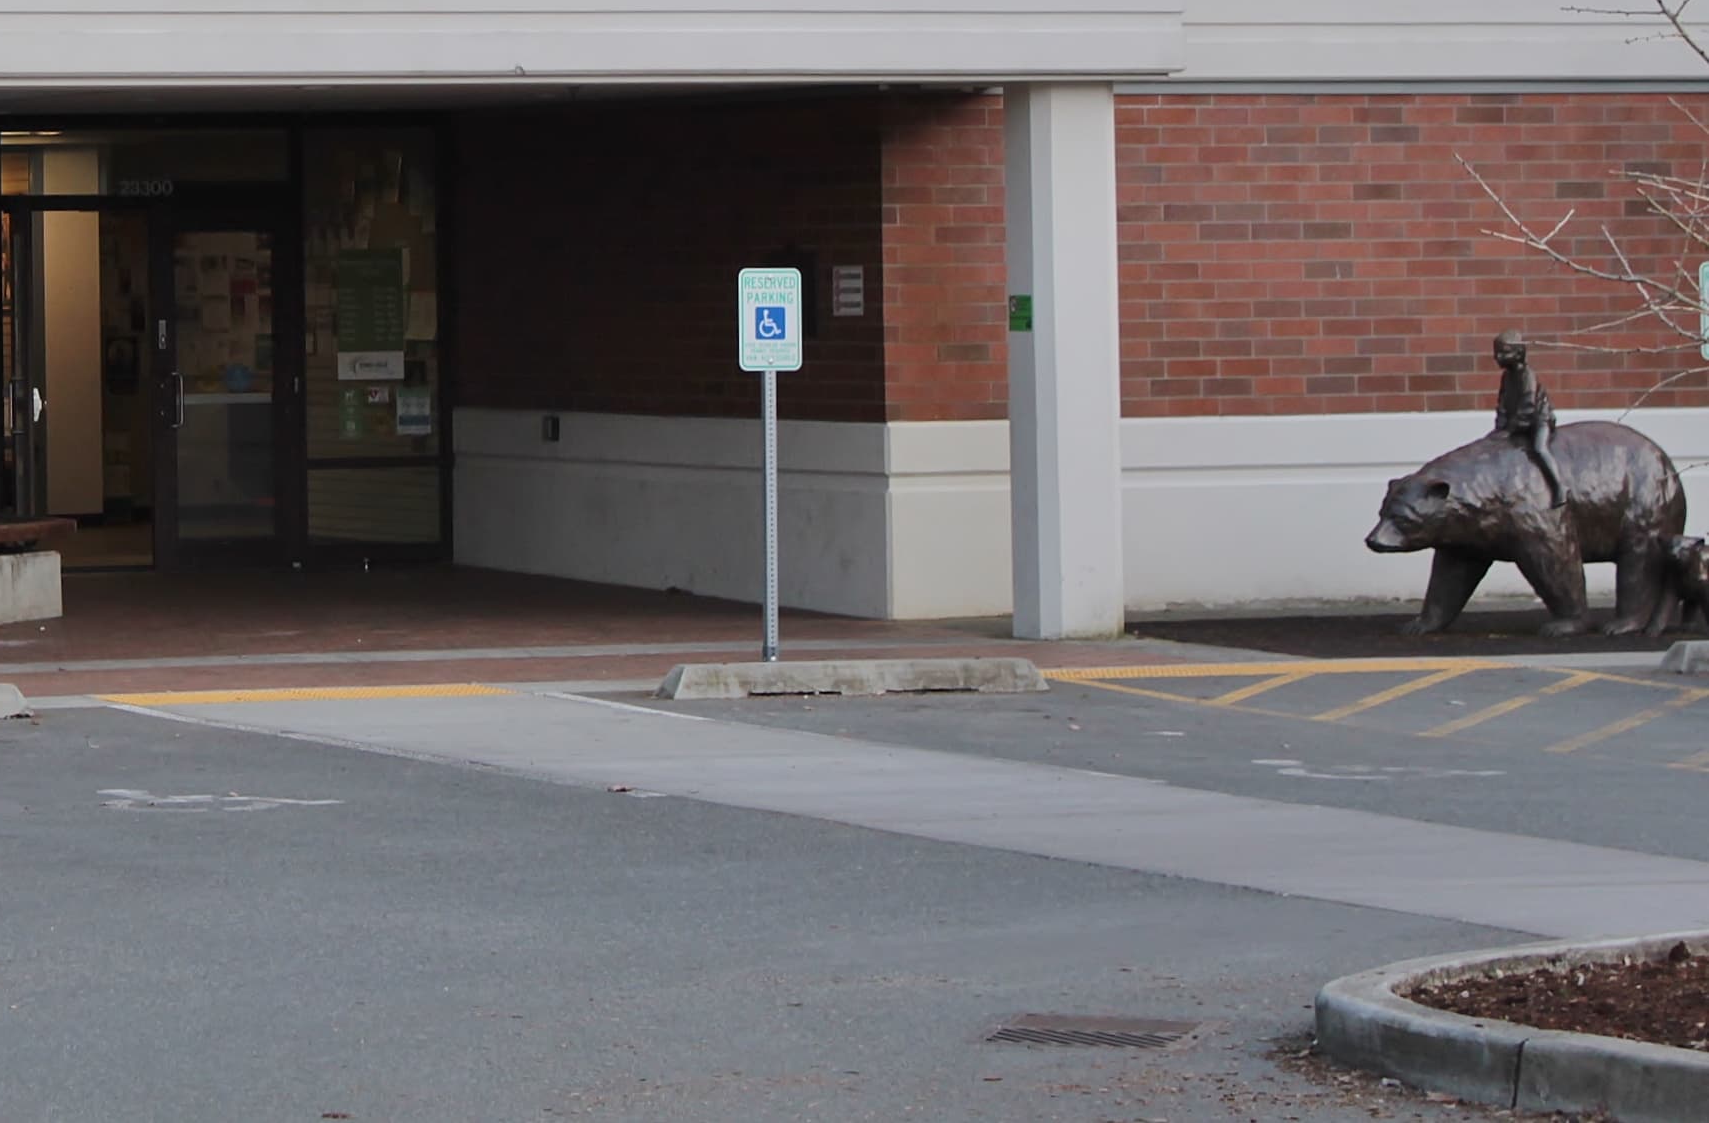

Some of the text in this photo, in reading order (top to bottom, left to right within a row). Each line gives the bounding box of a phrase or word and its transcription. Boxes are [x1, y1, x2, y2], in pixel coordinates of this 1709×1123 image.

[119, 180, 173, 196] 23300
[744, 276, 796, 289] RESERVED
[746, 292, 794, 305] PARKING
